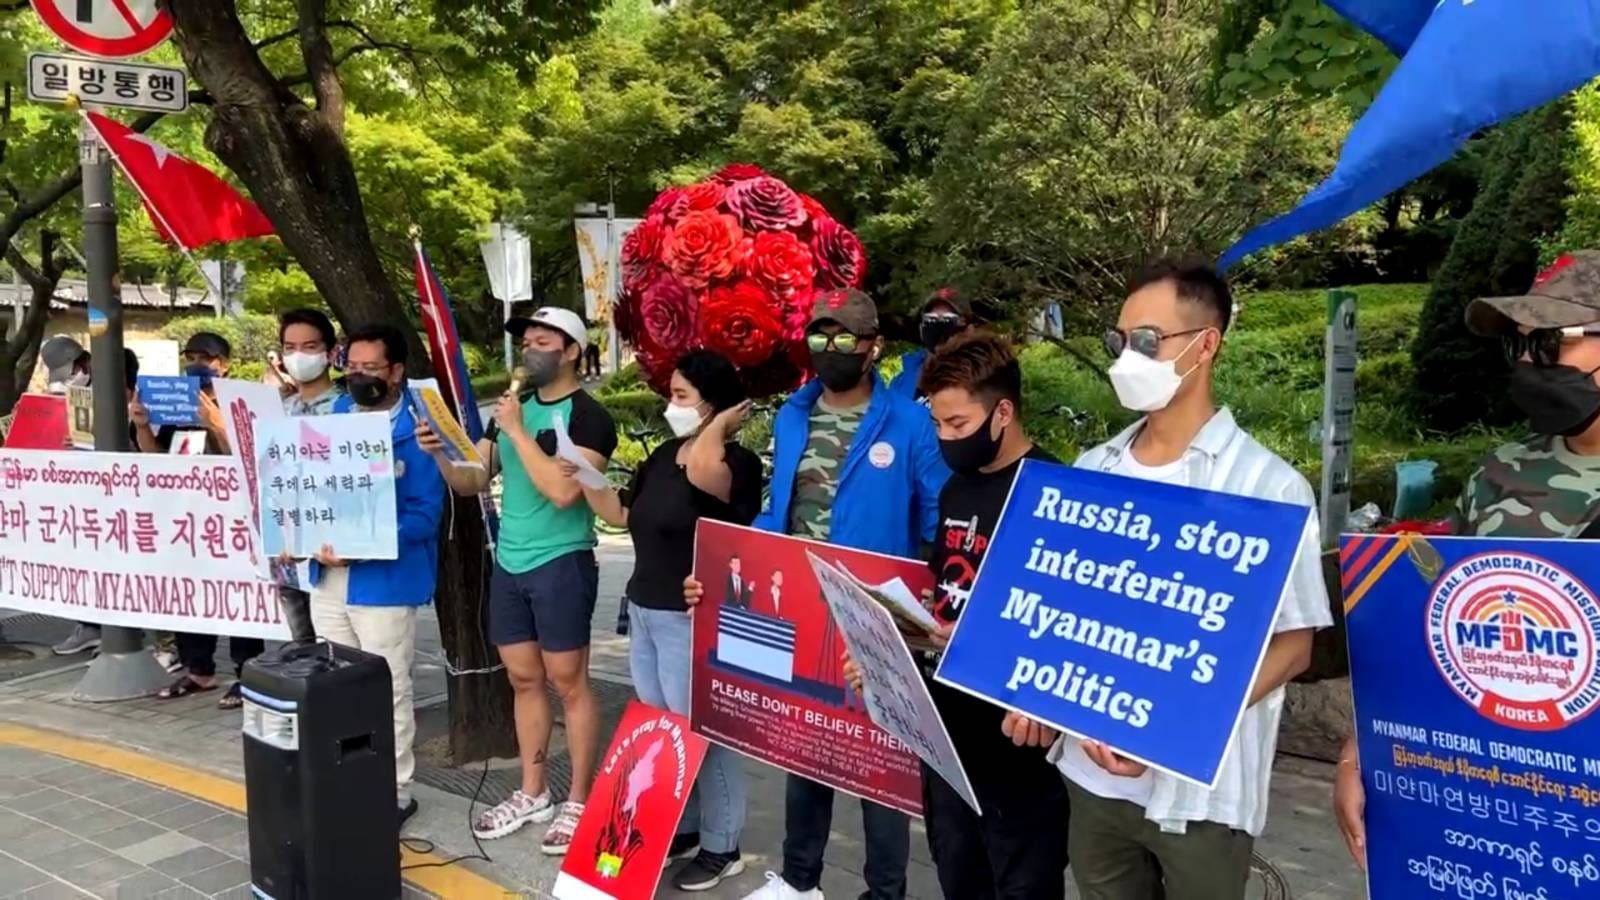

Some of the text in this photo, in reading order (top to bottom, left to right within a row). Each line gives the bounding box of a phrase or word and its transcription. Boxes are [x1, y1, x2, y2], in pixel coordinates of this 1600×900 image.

[42, 63, 175, 102] 일방통행
[268, 440, 388, 462] 러시아는 미얀마
[270, 473, 373, 494] 쿠데타 세력과
[38, 504, 159, 553] 군사독재를
[272, 507, 336, 527] 결별하라
[1033, 485, 1270, 575] Russia, stop
[21, 560, 90, 608] SUPPORT
[93, 571, 197, 618] MYANMAR
[1024, 538, 1234, 632] interfering
[1463, 557, 1560, 583] DEMOCRATIC
[1430, 576, 1462, 627] FEDERAL
[1006, 655, 1154, 729] politics
[1431, 633, 1479, 701] MYANMAR
[711, 679, 759, 706] PLEASE
[761, 695, 801, 721] DON'T
[804, 709, 864, 739] BELIEVE
[1494, 702, 1550, 724] KOREA
[658, 715, 674, 733] for
[670, 724, 687, 800] Myanmar
[1372, 719, 1428, 745] MYANMAR
[1432, 730, 1484, 756] FEDERAL
[1489, 741, 1577, 773] DEMOCRATIC
